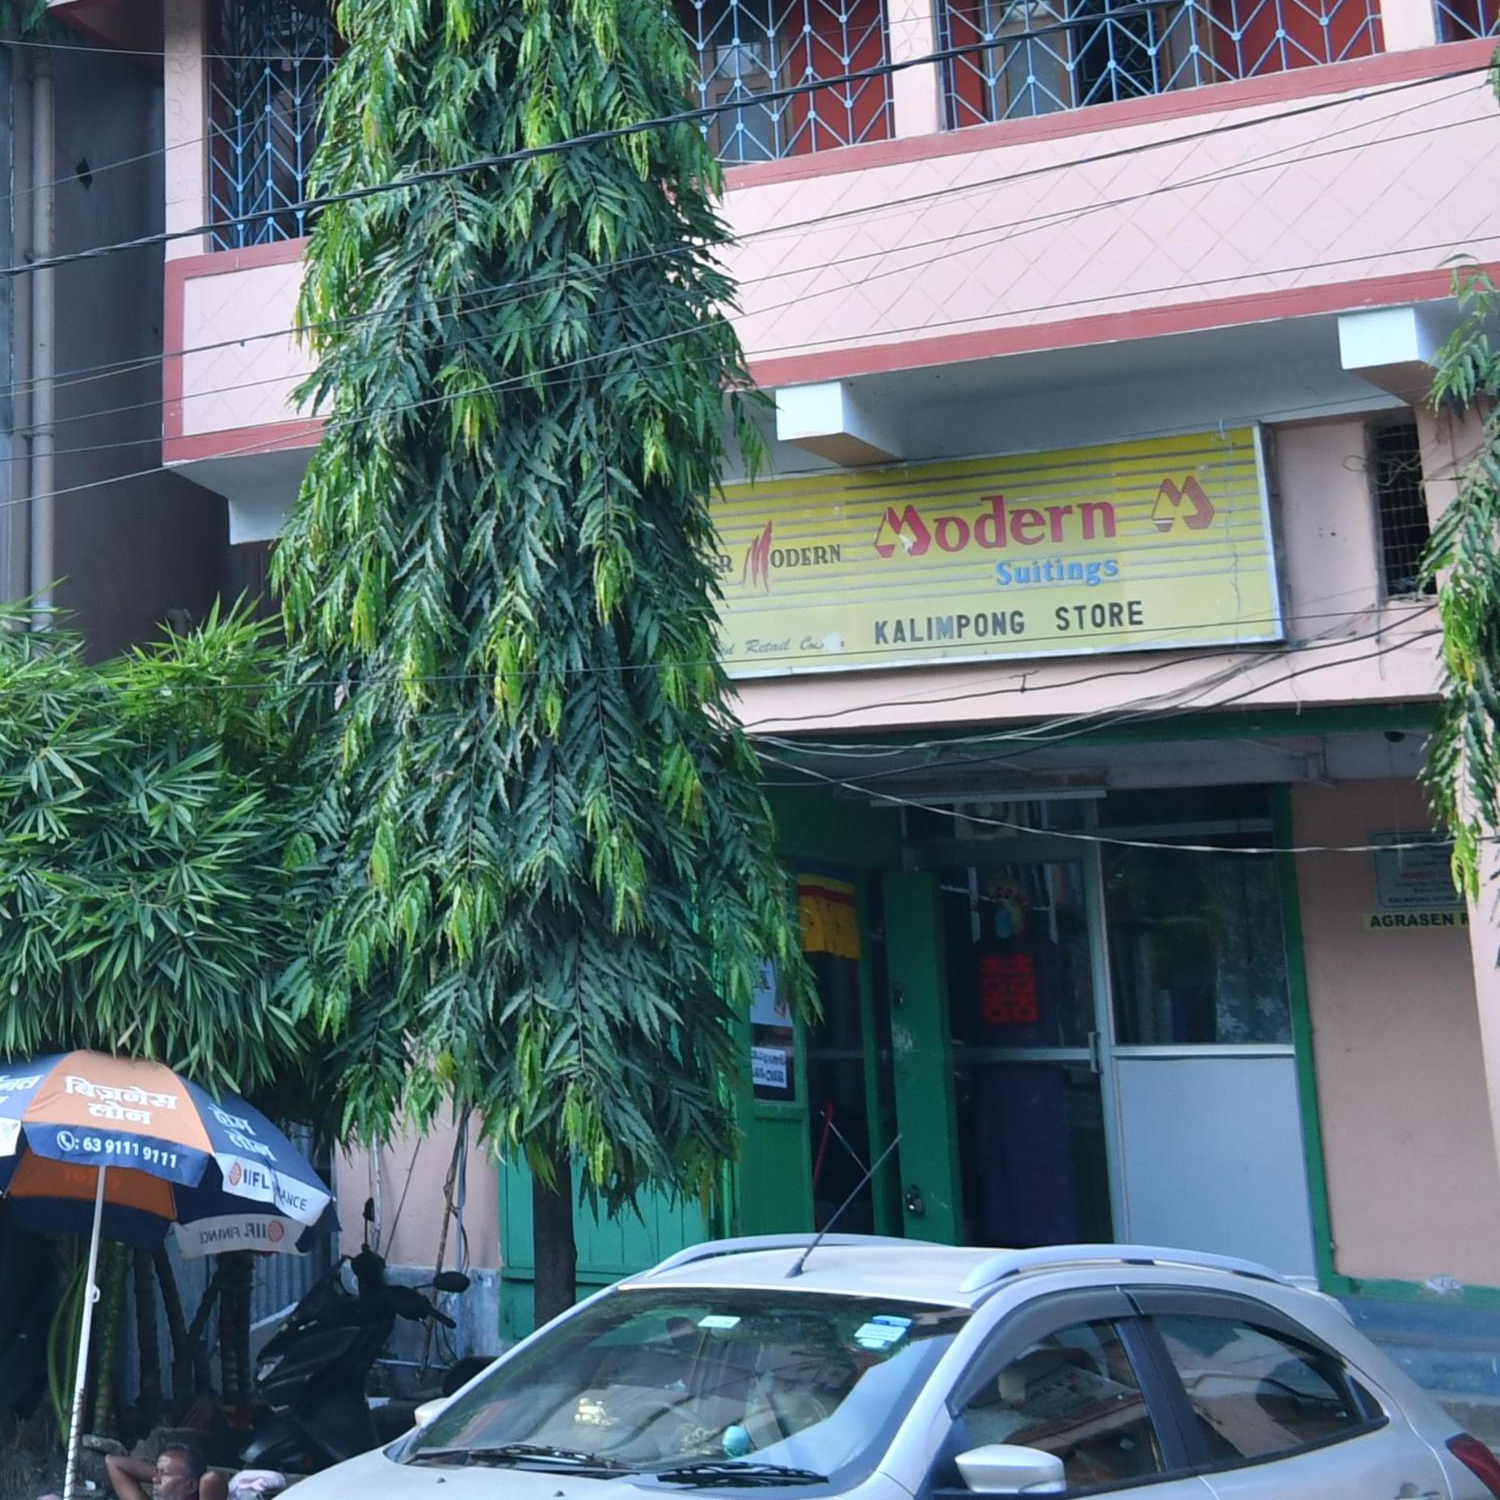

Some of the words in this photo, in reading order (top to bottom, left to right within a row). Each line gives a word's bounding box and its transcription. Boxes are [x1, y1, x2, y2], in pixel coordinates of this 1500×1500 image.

[874, 495, 1117, 559] Modern
[996, 558, 1119, 587] Suitings
[874, 609, 1026, 645] KALIMPONG
[1055, 600, 1145, 631] STORE
[745, 638, 791, 655] Retail
[1370, 913, 1455, 928] AGRASEN
[88, 1099, 152, 1125] लोन
[82, 1136, 101, 1153] 63
[104, 1138, 140, 1158] 9111
[142, 1144, 178, 1169] 9111
[242, 1166, 271, 1190] IIFL
